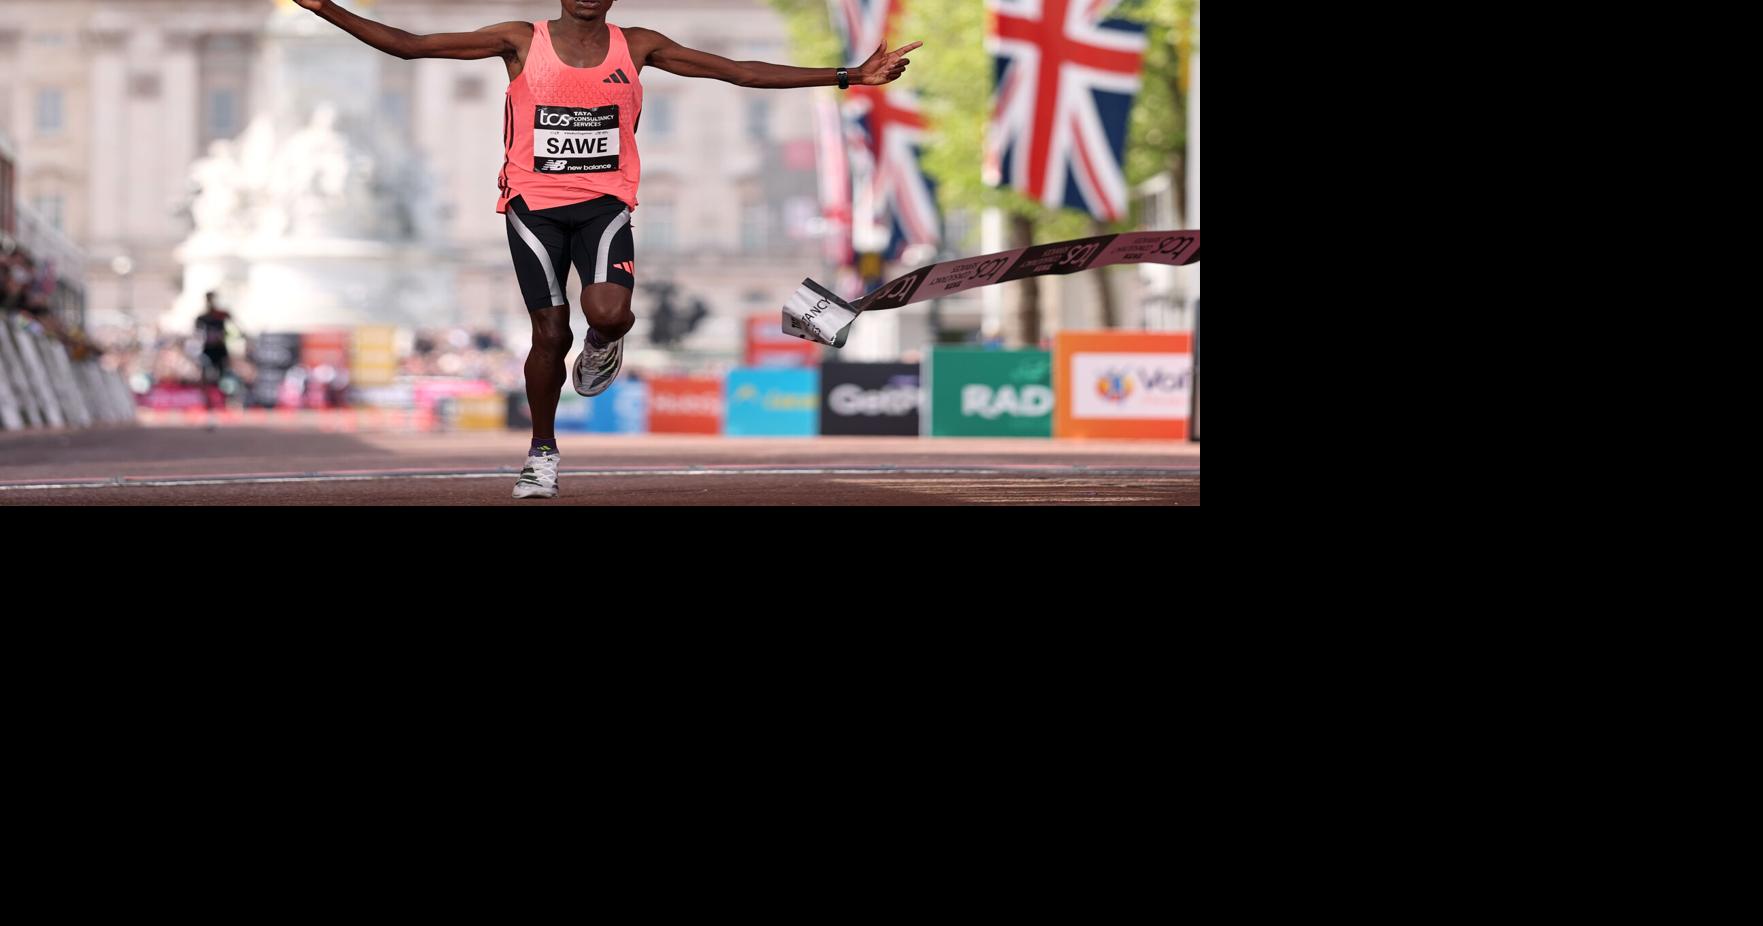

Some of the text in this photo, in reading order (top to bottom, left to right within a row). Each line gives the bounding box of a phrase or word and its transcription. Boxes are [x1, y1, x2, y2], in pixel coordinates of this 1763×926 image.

[540, 109, 571, 126] tcs
[573, 114, 614, 122] CONSULTANCY
[546, 137, 608, 154] SAWE
[583, 163, 612, 171] balance
[1058, 242, 1099, 268] tcs
[969, 256, 1009, 281] tcs
